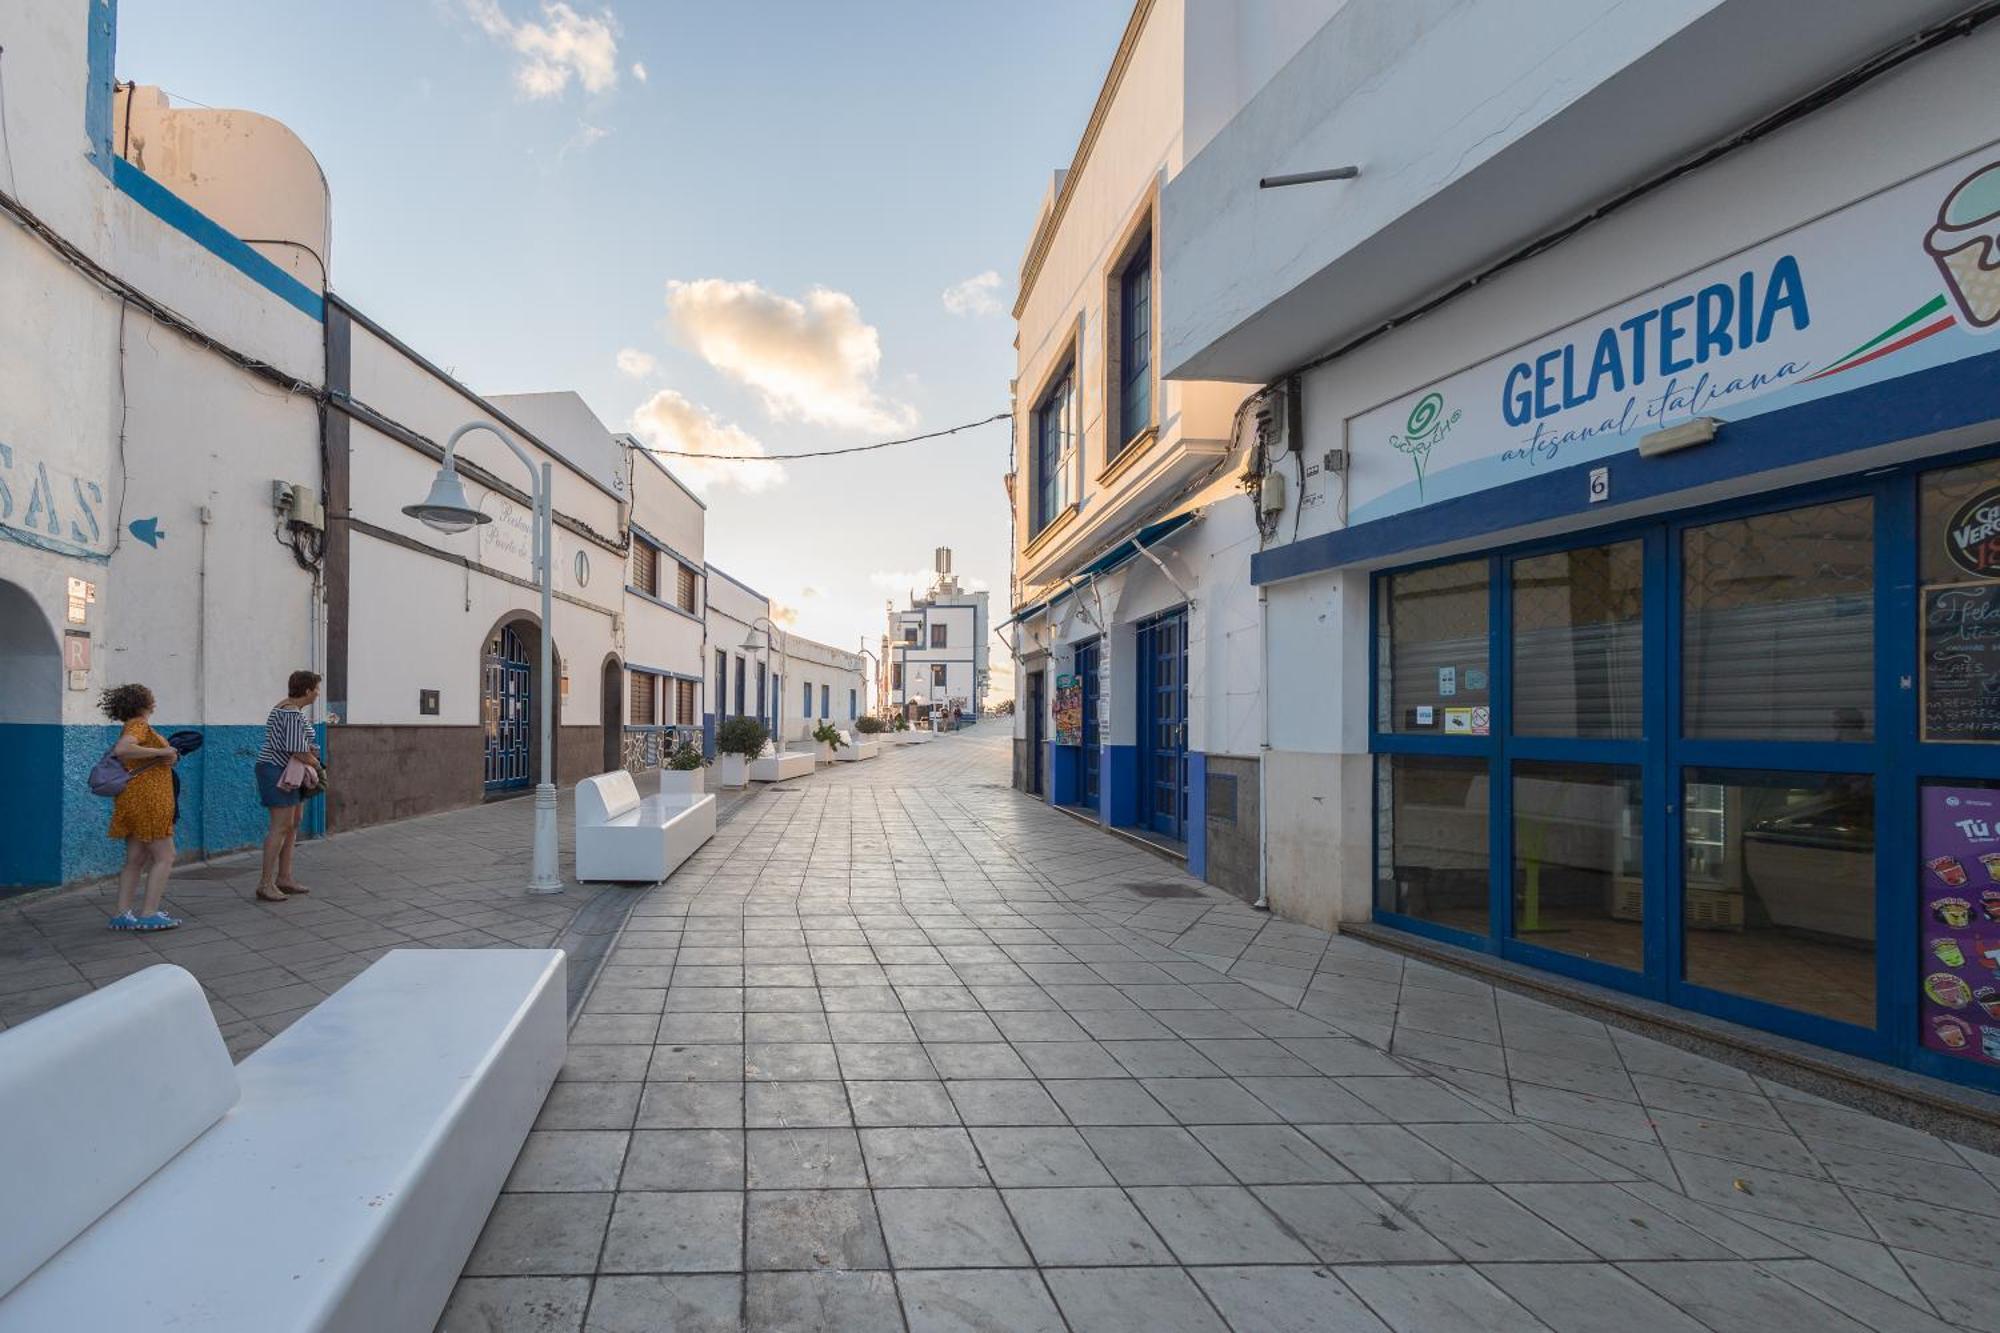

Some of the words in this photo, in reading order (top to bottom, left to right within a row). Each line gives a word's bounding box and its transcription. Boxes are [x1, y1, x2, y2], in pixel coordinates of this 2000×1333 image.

[1502, 255, 1810, 428] GELATERIA
[1501, 397, 1640, 466] artesanal
[1647, 360, 1810, 428] italiana
[1591, 475, 1605, 494] 6
[1955, 818, 1990, 837] Tú
